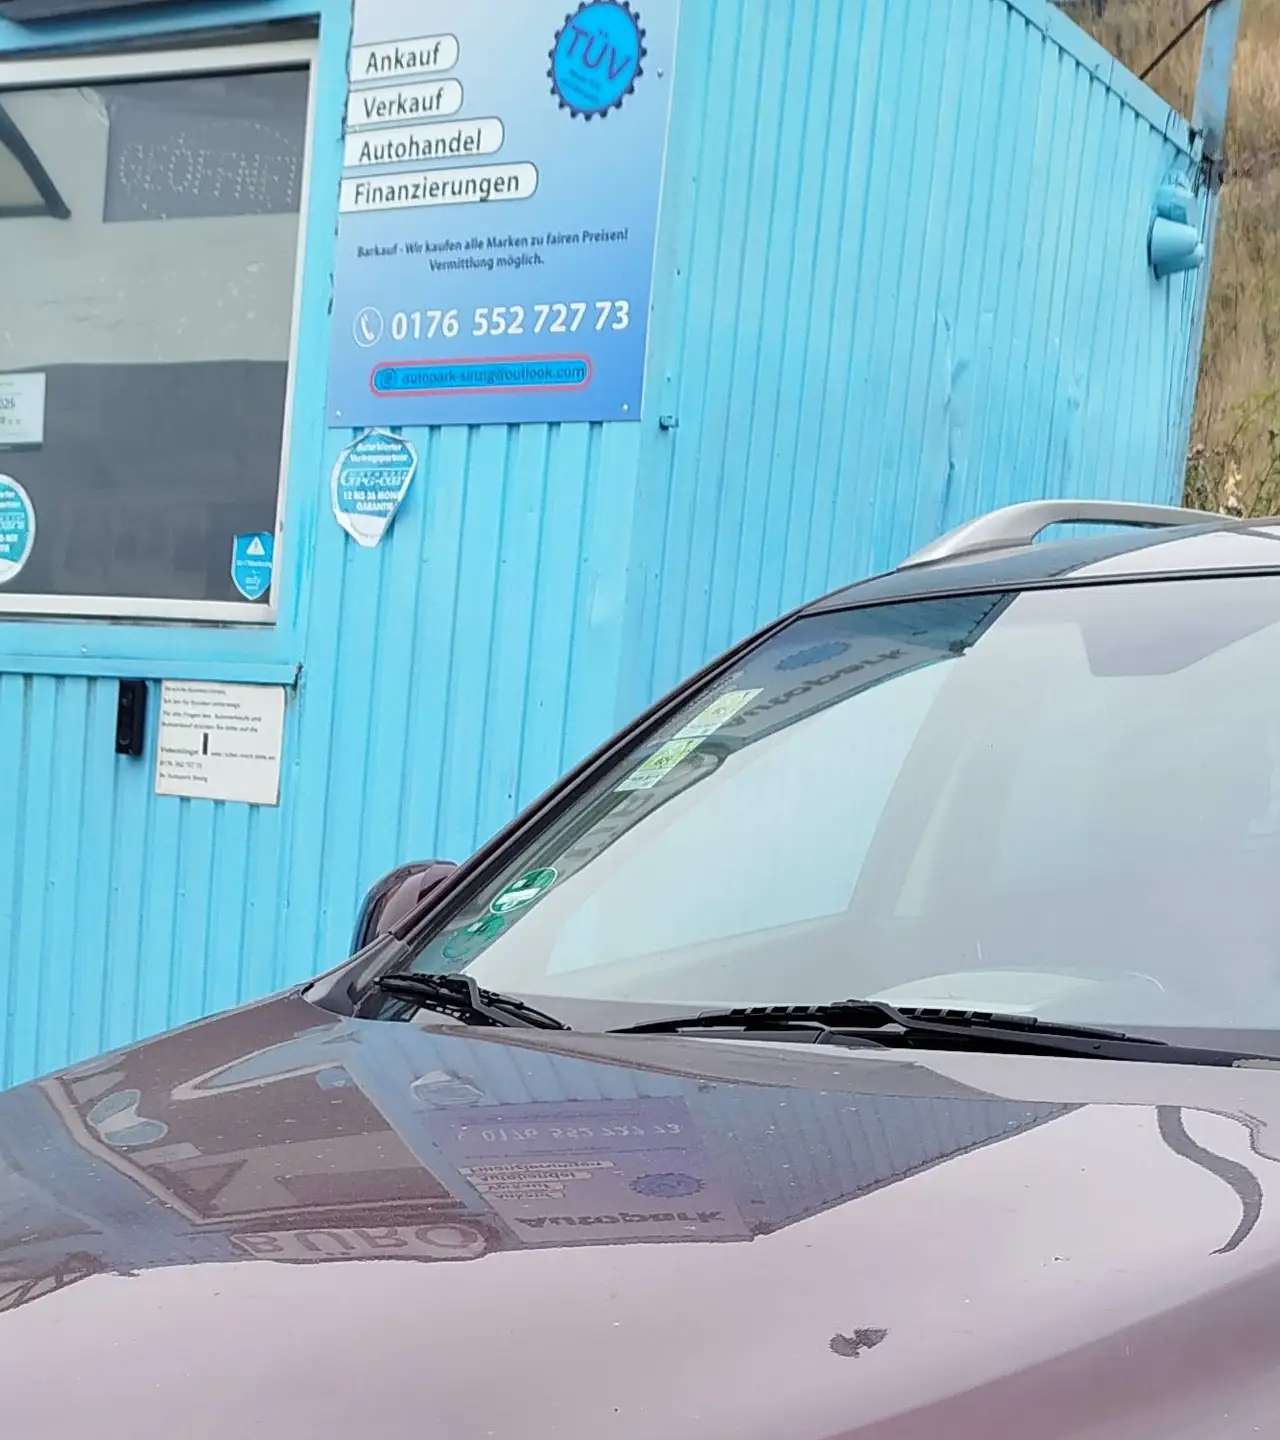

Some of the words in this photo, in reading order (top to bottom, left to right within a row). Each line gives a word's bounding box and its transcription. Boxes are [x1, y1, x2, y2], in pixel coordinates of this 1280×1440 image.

[365, 41, 441, 74] Ankauf
[568, 25, 632, 82] TÜV
[363, 87, 444, 118] Verkauf
[359, 128, 482, 163] Autohandel
[354, 173, 520, 205] Finanzierungen
[357, 243, 398, 257] Barkauf
[405, 241, 423, 254] Wir
[425, 238, 462, 253] kaufen
[465, 237, 484, 251] alle
[486, 234, 529, 249] Marken
[531, 235, 544, 247] zu
[546, 230, 580, 246] fairen
[582, 228, 628, 243] Preisen!
[429, 253, 494, 272] Vermittlung
[496, 251, 544, 269] möglich.
[391, 309, 459, 341] 0176
[472, 305, 525, 336] 552
[533, 301, 587, 334] 727
[594, 299, 630, 331] 73
